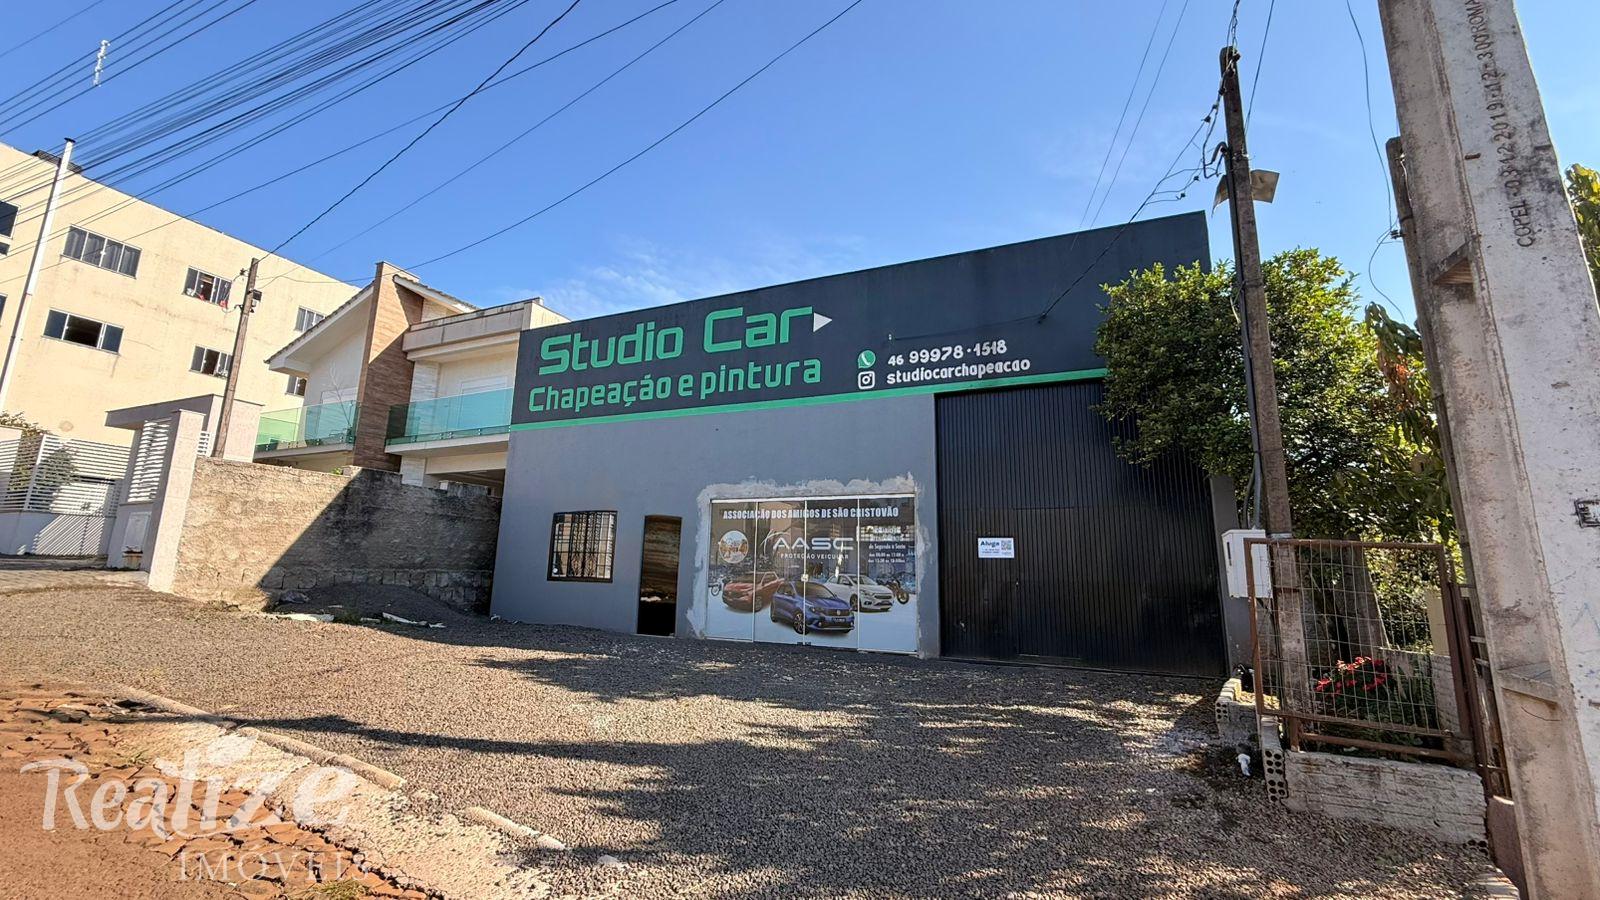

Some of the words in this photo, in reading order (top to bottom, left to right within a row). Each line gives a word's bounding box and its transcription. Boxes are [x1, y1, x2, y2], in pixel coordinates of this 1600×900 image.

[1509, 199, 1536, 249] COPEL
[538, 321, 684, 375] Studio
[703, 306, 814, 354] Car
[886, 359, 1031, 385] studiocarchapeacao
[887, 354, 905, 367] 46
[677, 373, 694, 398] e
[700, 358, 822, 400] pintura
[771, 509, 787, 518] DOS
[787, 508, 820, 519] AMIGOS
[821, 508, 832, 518] DE
[832, 506, 849, 518] SÃO
[850, 505, 899, 518] CRISTOVÃO
[772, 537, 854, 551] AASC
